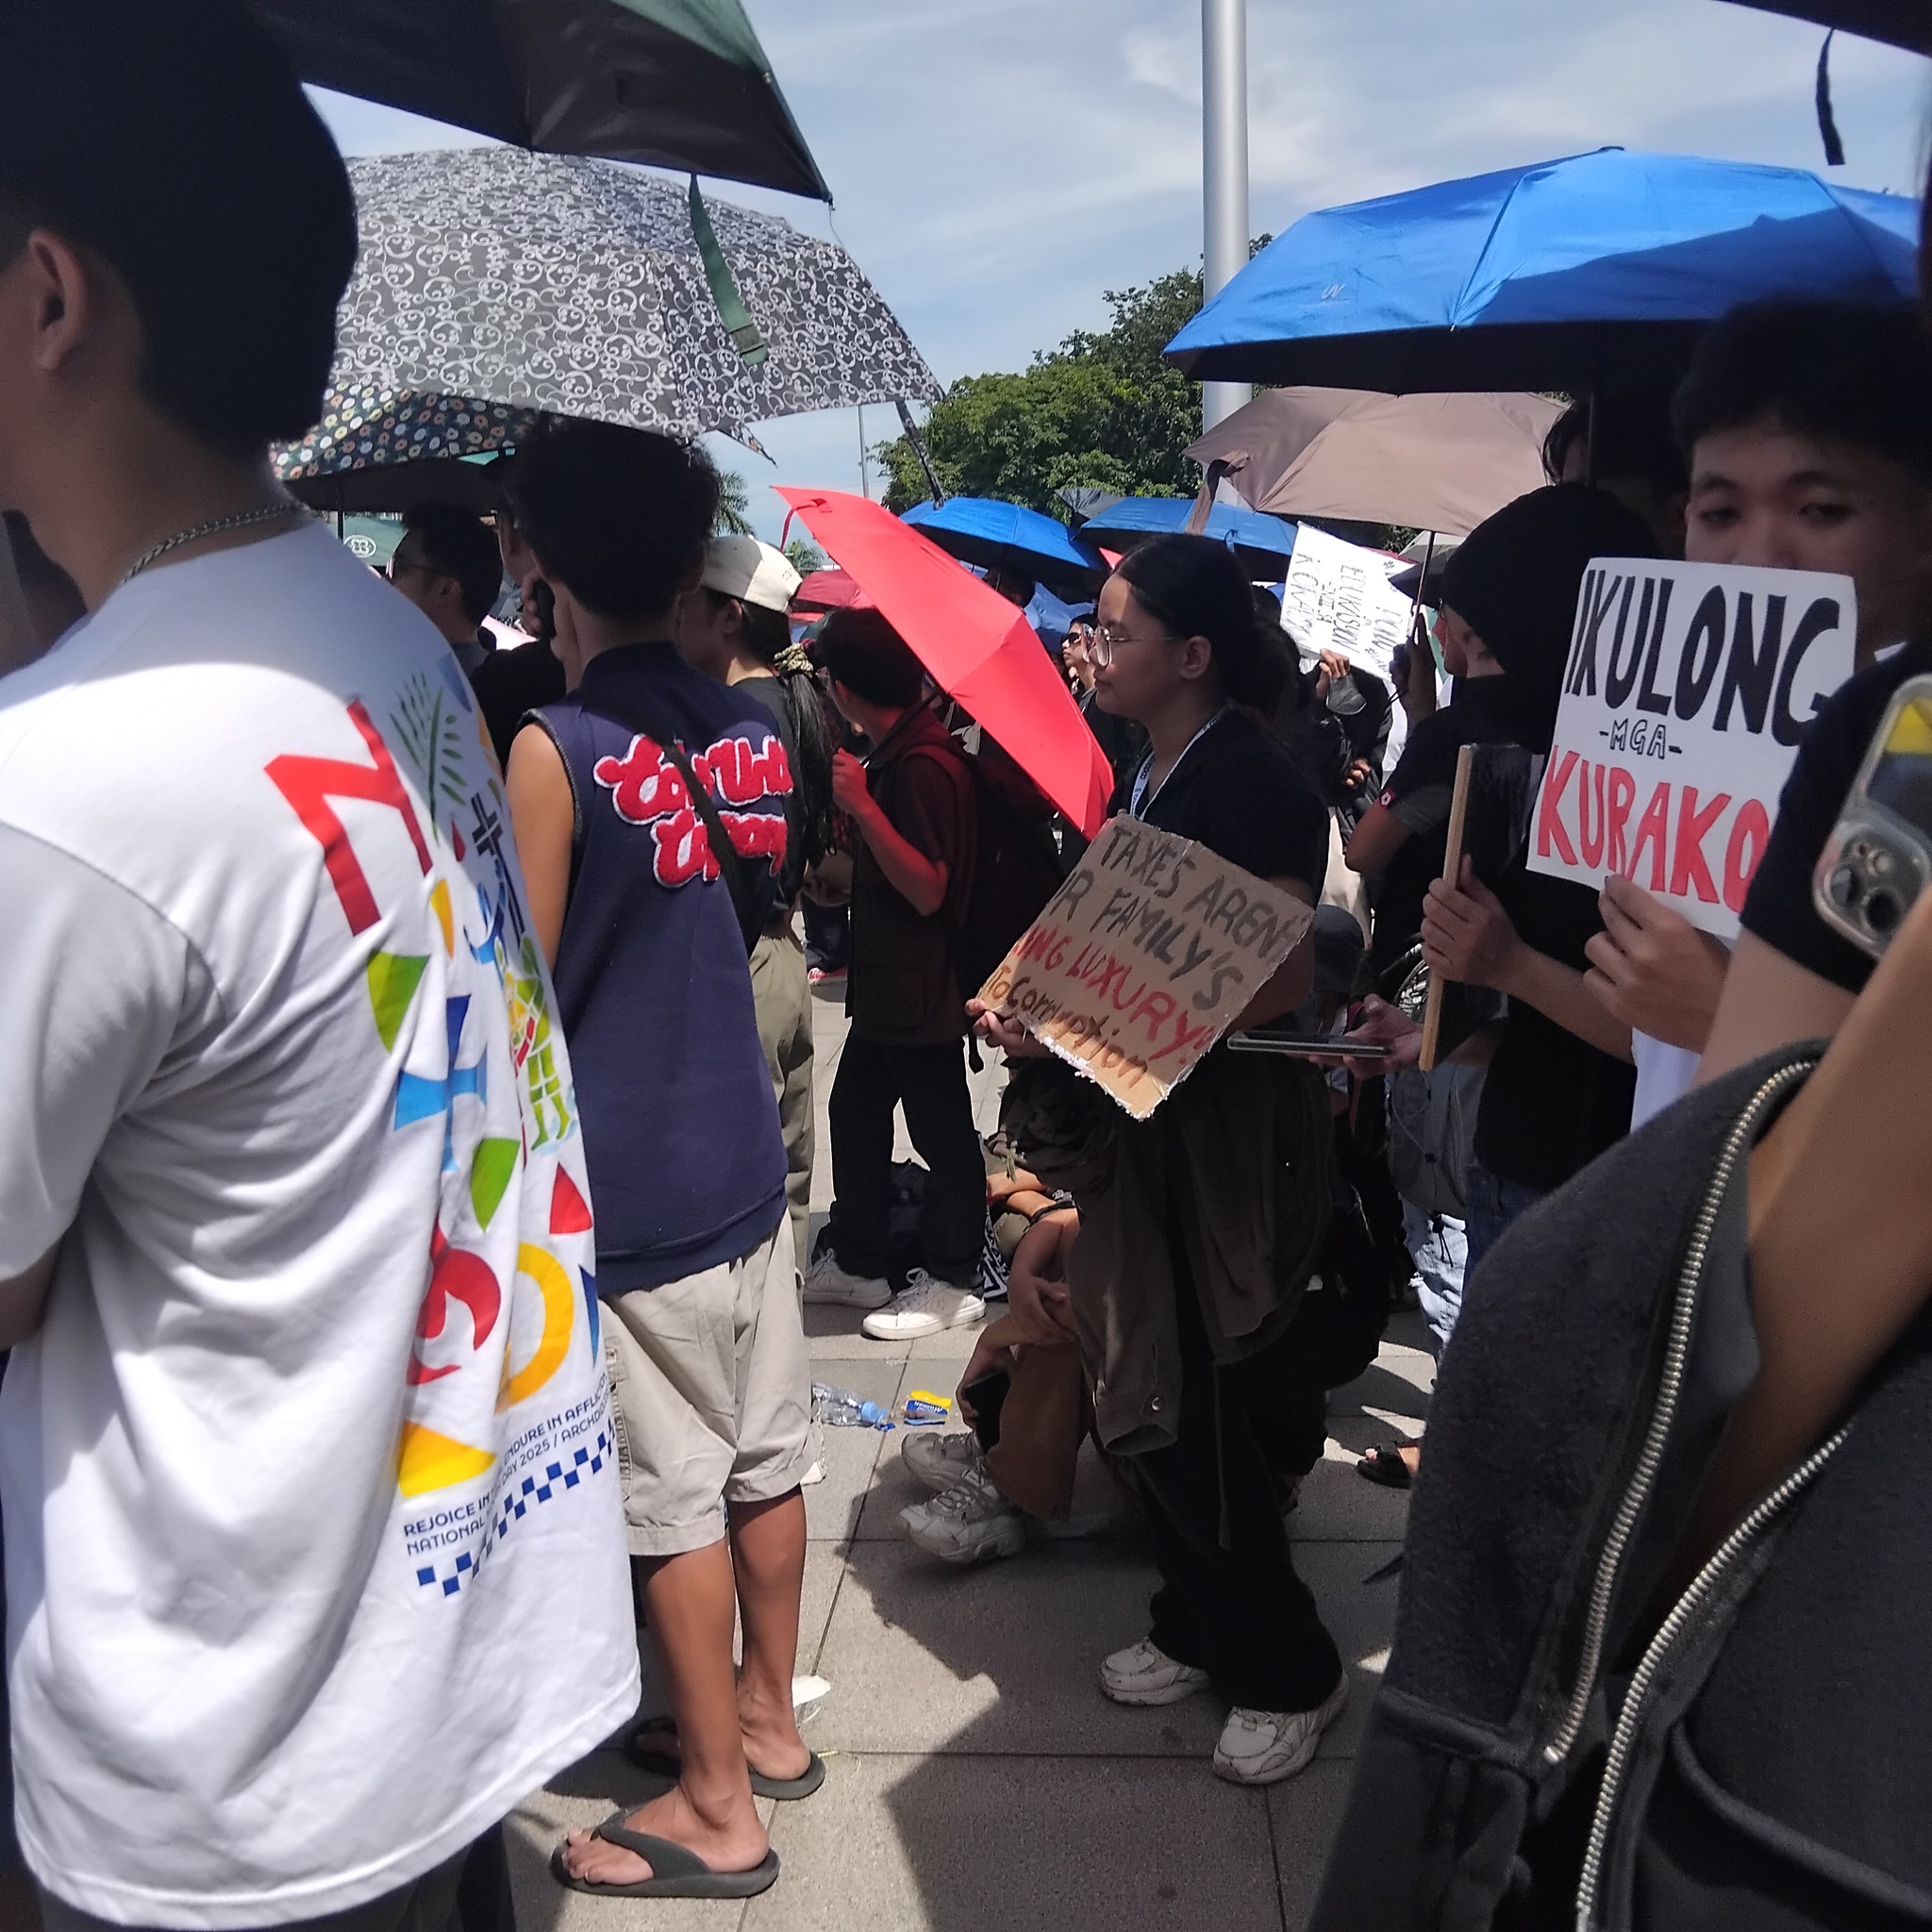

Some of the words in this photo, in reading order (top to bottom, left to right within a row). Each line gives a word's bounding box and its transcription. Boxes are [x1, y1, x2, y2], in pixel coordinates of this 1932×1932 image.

[1565, 569, 1840, 746] IKULONG
[1101, 824, 1196, 898] TAXES
[1538, 745, 1771, 913] KURAKO
[1090, 888, 1243, 1011] FAMILY'S
[403, 1502, 476, 1537] REJOICE
[477, 1491, 491, 1510] IN
[504, 1423, 545, 1466] ENDURE
[547, 1413, 562, 1431] IN
[407, 1516, 485, 1557] NATIONAL
[502, 1461, 517, 1486] DAY
[520, 1436, 551, 1468] 2025
